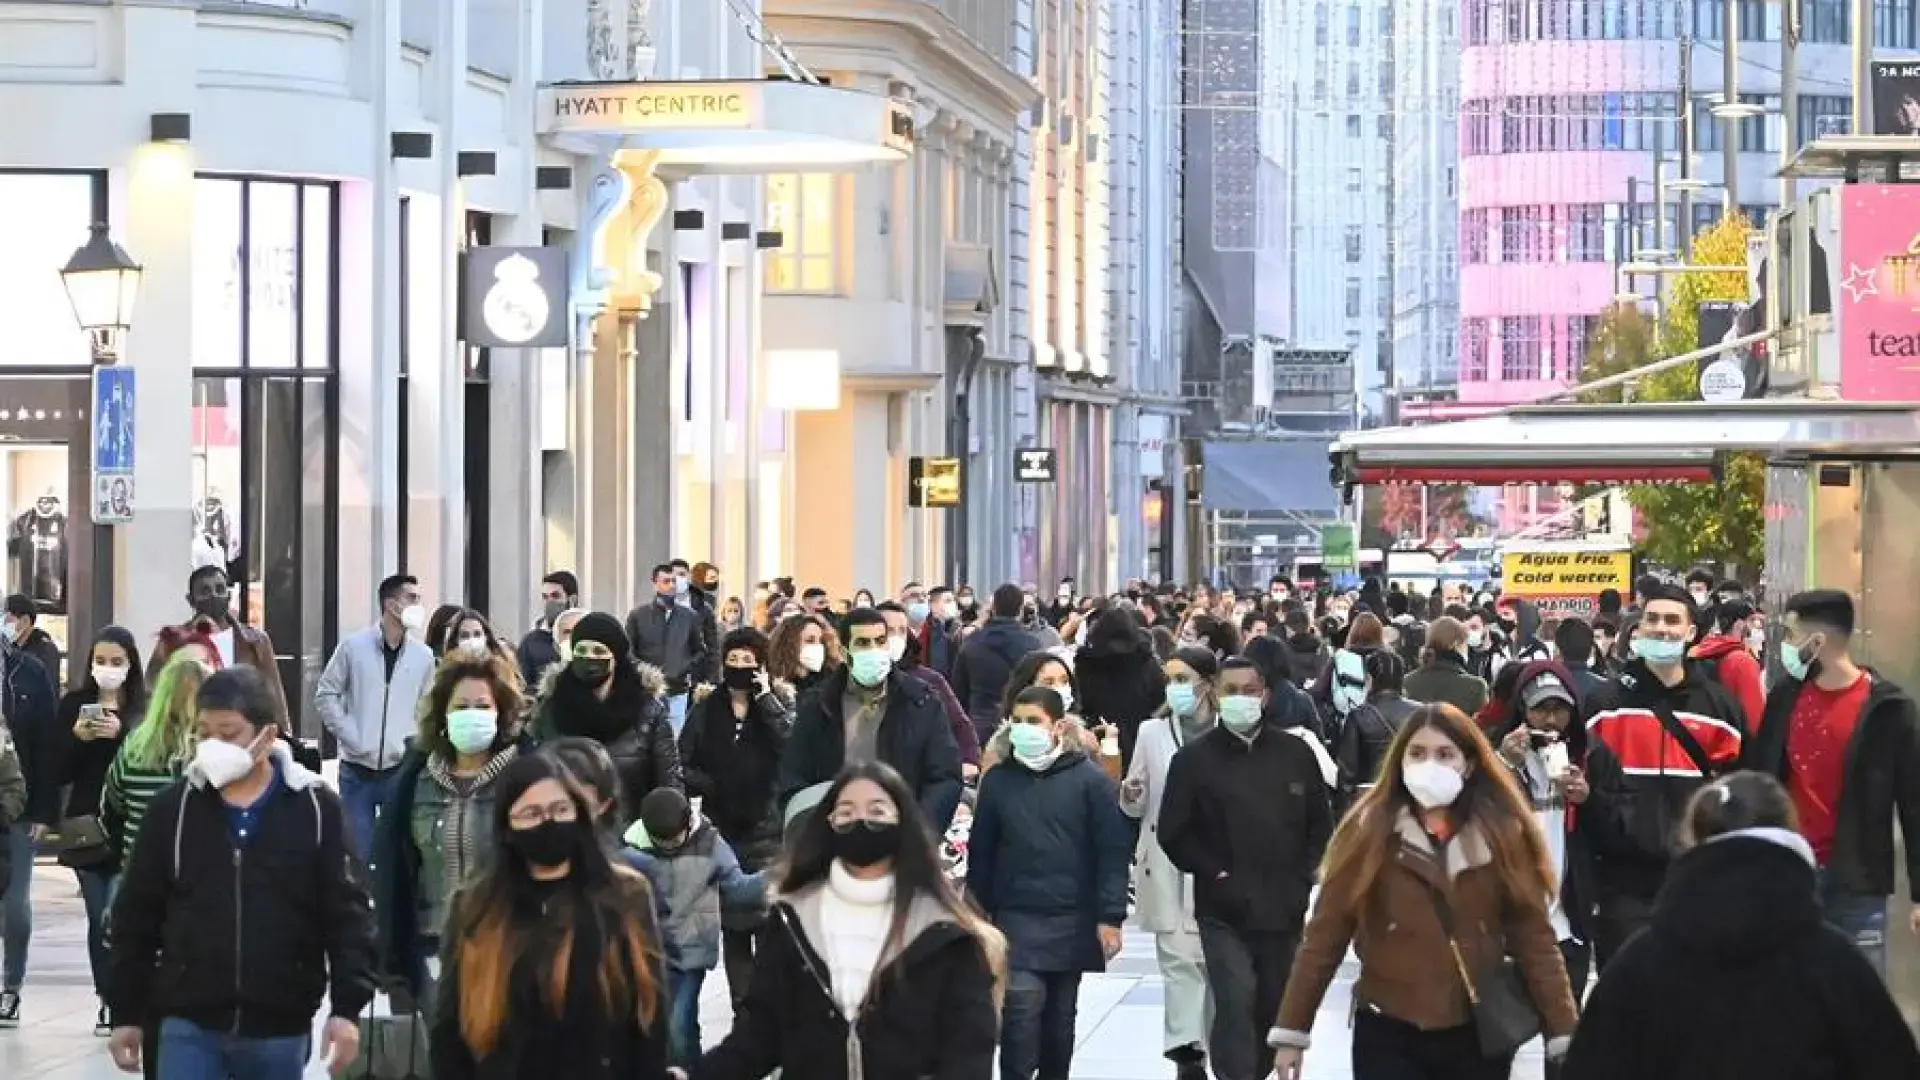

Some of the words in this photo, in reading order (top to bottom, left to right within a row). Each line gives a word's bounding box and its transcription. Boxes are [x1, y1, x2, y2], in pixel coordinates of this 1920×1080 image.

[556, 97, 628, 116] HYATT
[635, 94, 741, 116] CENTRIC
[1868, 329, 1920, 356] tea
[1519, 553, 1569, 568] Agua
[1513, 572, 1554, 583] Cold
[1559, 572, 1621, 583] water.
